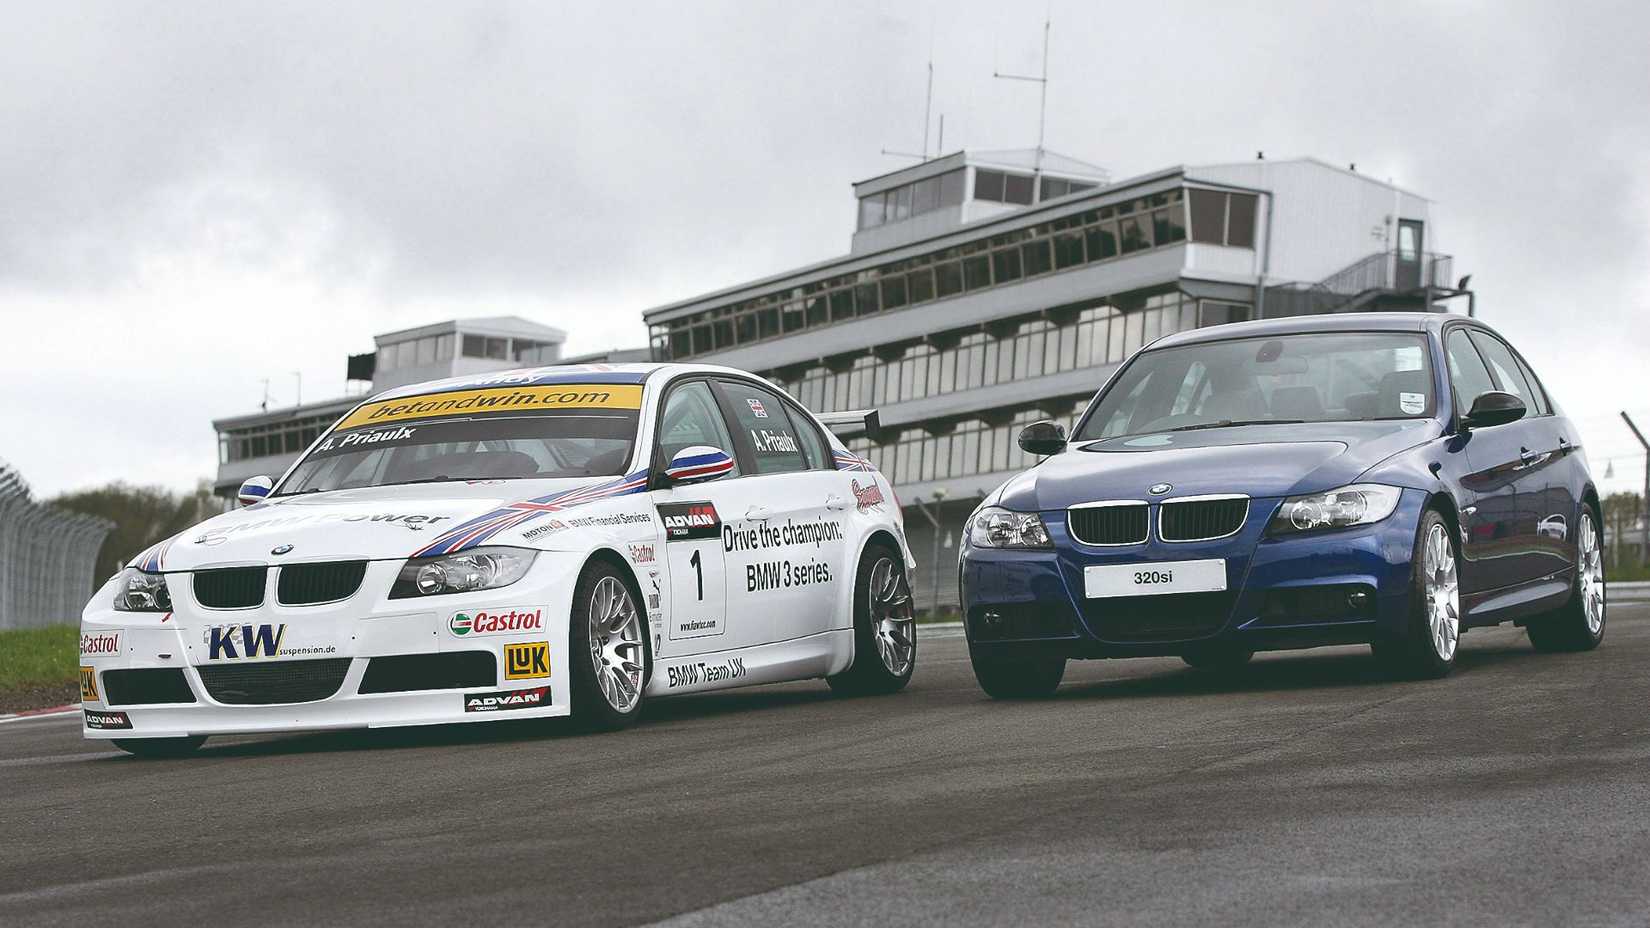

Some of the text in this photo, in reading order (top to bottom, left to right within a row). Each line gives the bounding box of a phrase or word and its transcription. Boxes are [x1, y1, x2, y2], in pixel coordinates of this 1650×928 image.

[368, 391, 611, 420] betandwin.com
[312, 427, 417, 454] A. Priaulx
[621, 511, 651, 524] Services
[665, 514, 715, 528] ADVAN
[724, 515, 843, 553] Drive the champion:
[690, 549, 703, 601] 1
[746, 558, 833, 592] BMW 3 series.
[1134, 570, 1173, 585] 320si
[475, 609, 541, 633] Castrol
[83, 633, 119, 654] Castrol
[208, 623, 287, 661] KW
[279, 645, 336, 657] suspension.de
[667, 657, 746, 688] BMW Team UK
[468, 693, 540, 707] ADVAN
[87, 715, 123, 725] ADVAN
